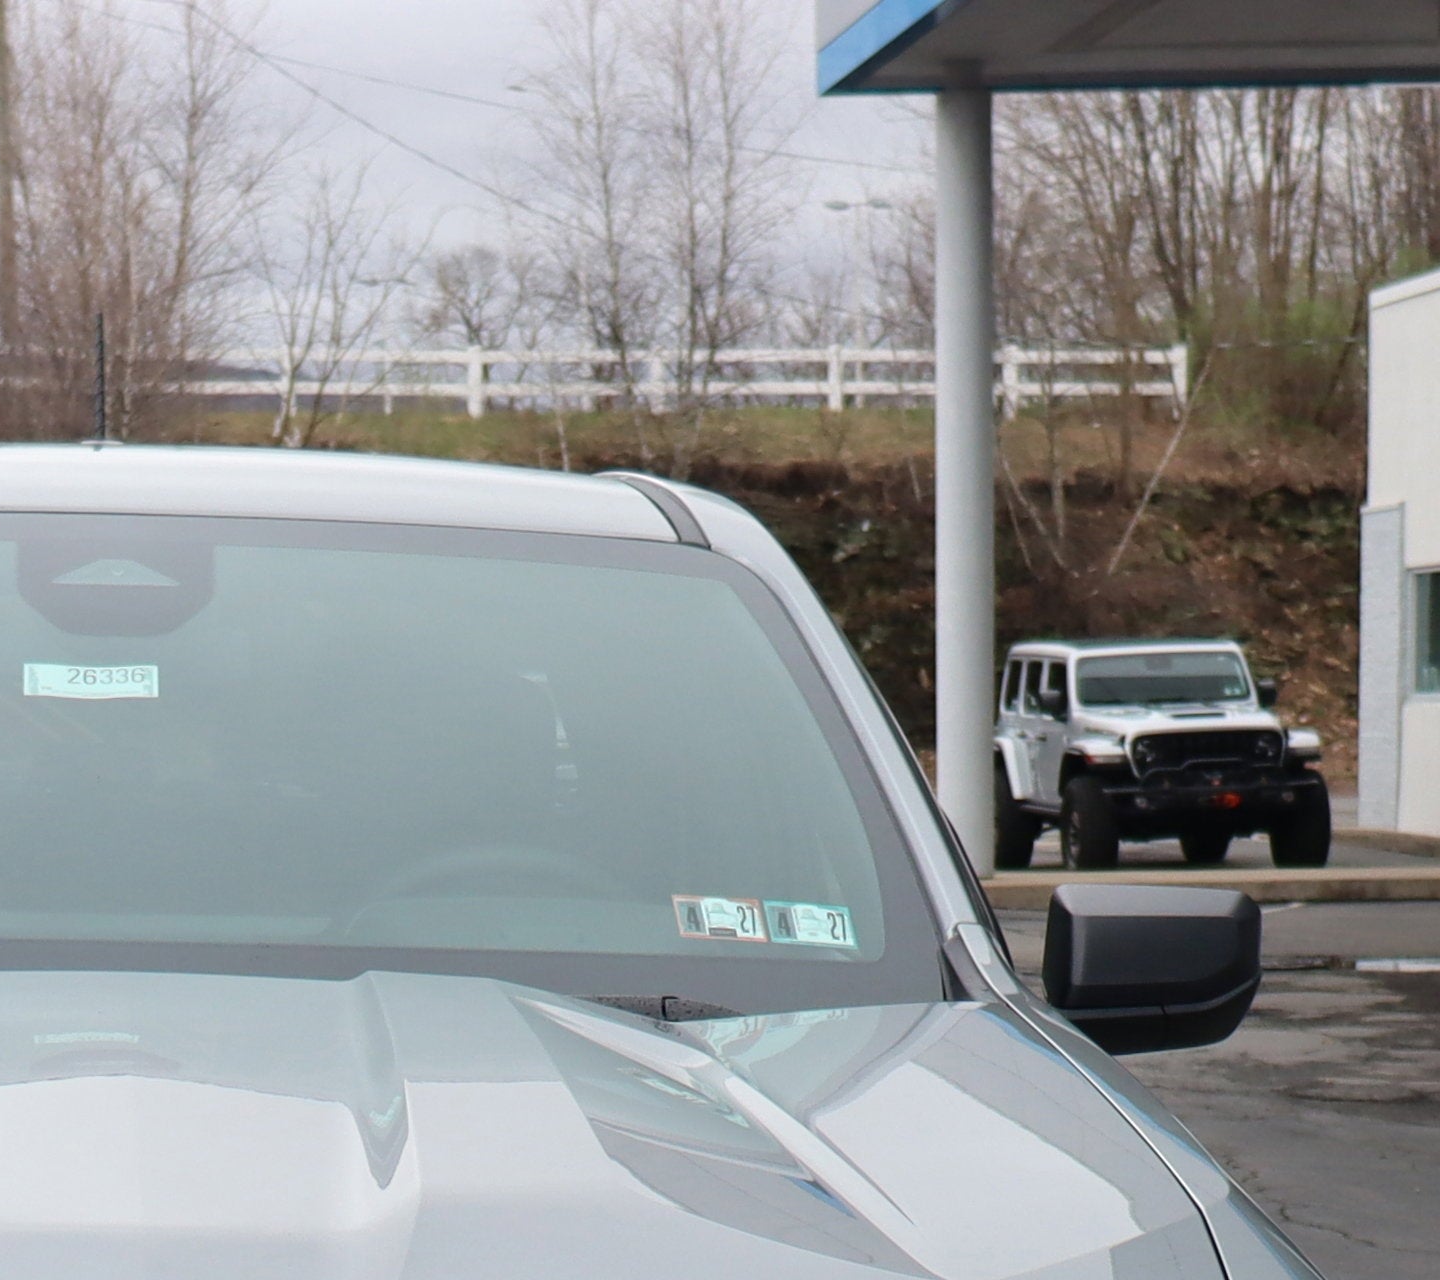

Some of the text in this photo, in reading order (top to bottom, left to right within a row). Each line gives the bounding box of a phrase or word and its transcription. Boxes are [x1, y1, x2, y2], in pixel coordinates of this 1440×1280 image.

[67, 668, 145, 685] 26336
[737, 906, 756, 934] 27
[827, 912, 846, 941] 27
